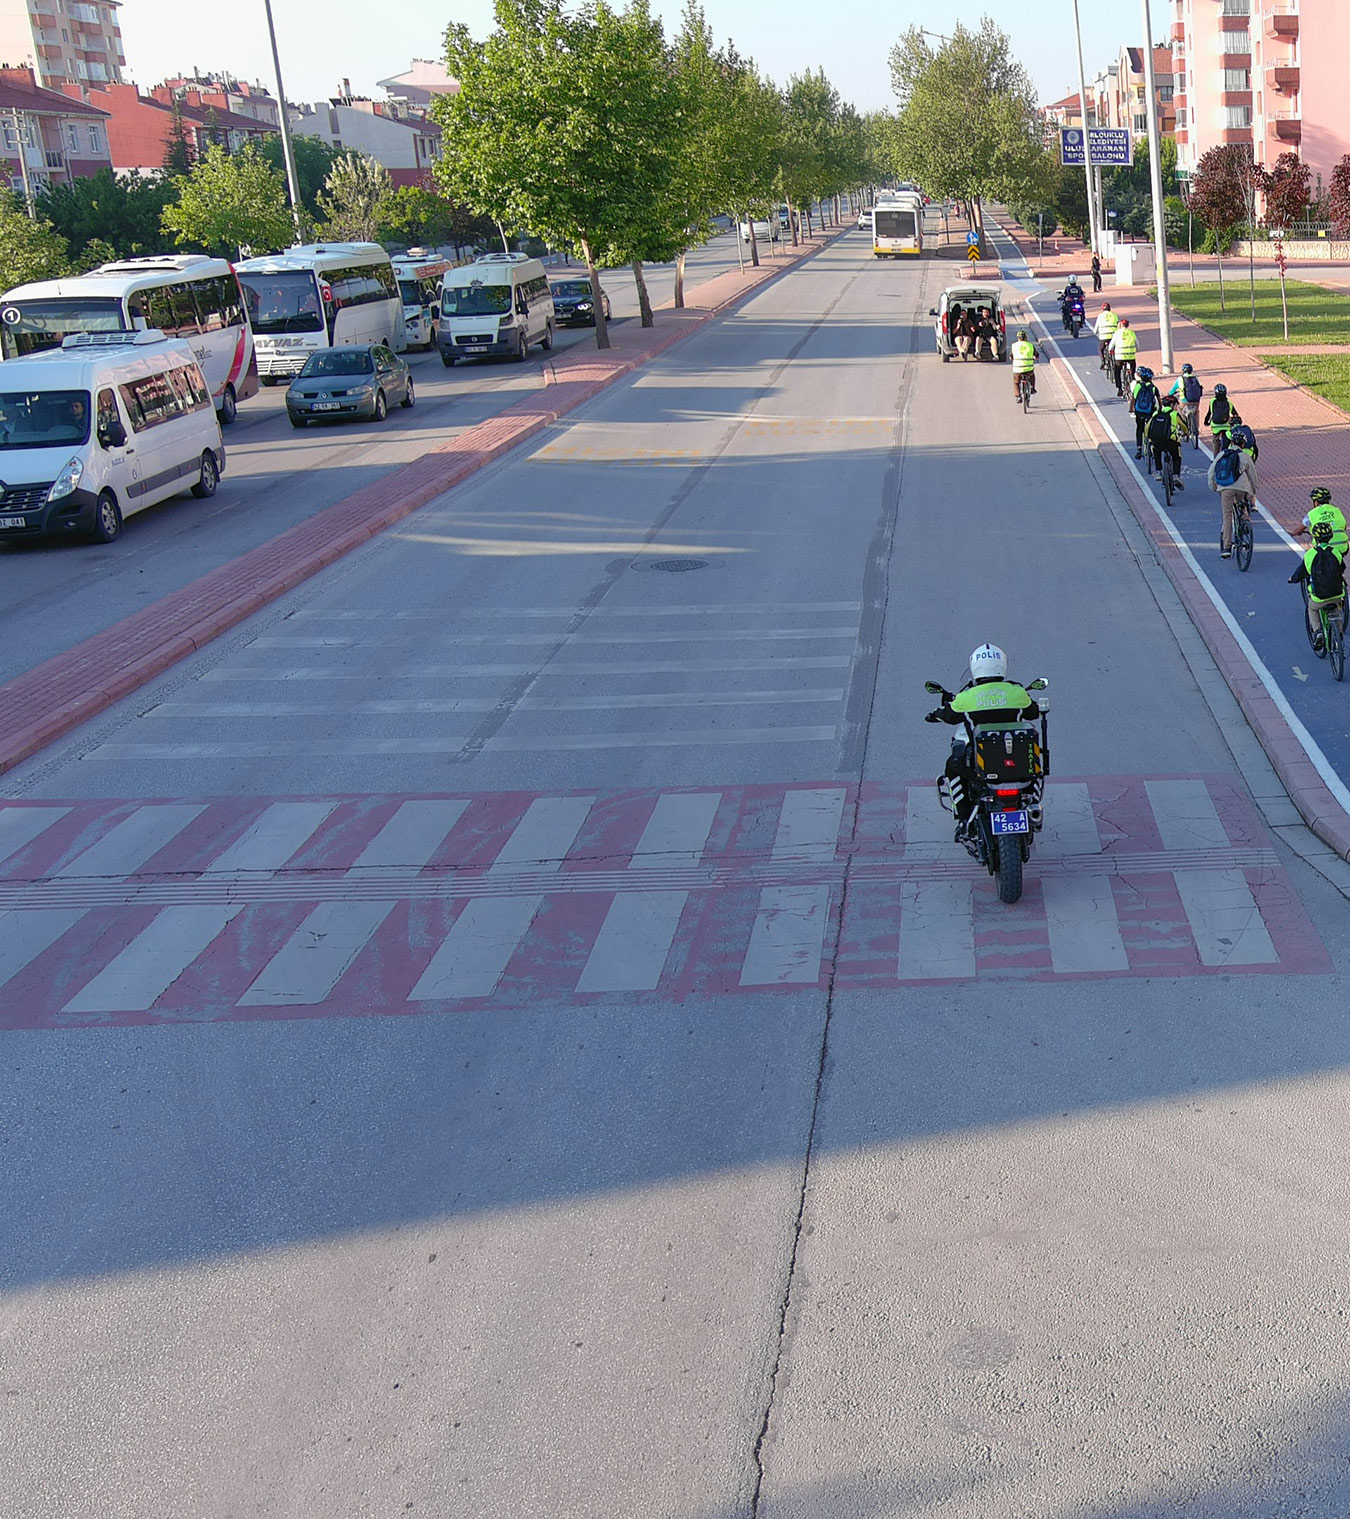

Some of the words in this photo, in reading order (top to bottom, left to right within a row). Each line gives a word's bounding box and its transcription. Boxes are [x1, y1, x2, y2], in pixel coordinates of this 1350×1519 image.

[7, 311, 14, 321] 1
[994, 814, 1007, 822] 42
[1019, 813, 1025, 821] A
[1001, 822, 1026, 831] 5634
